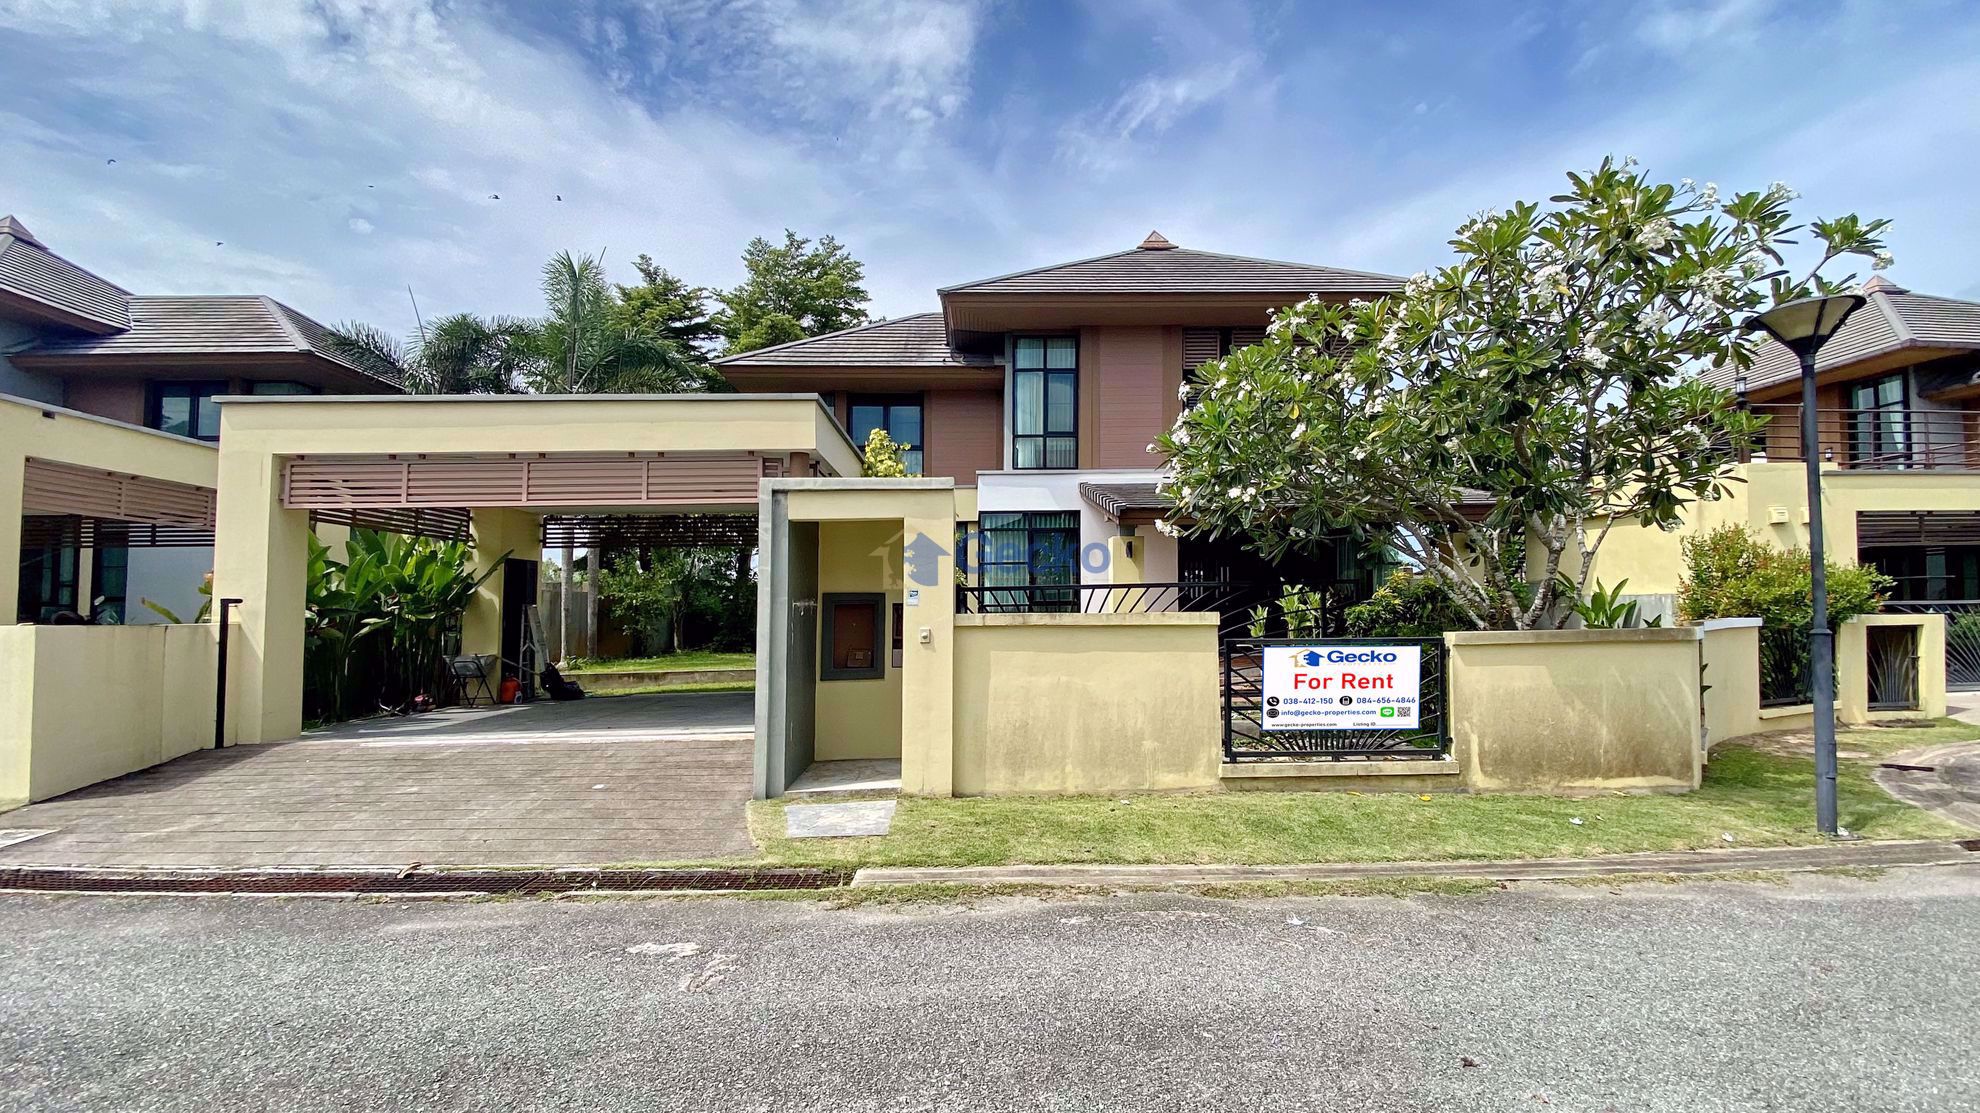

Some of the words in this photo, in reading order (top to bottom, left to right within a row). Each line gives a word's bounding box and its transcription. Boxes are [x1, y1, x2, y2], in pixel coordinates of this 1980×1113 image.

[1327, 650, 1397, 663] Gecko
[1294, 673, 1333, 689] For
[1341, 673, 1394, 689] Rent
[1283, 697, 1333, 705] 038-412-150
